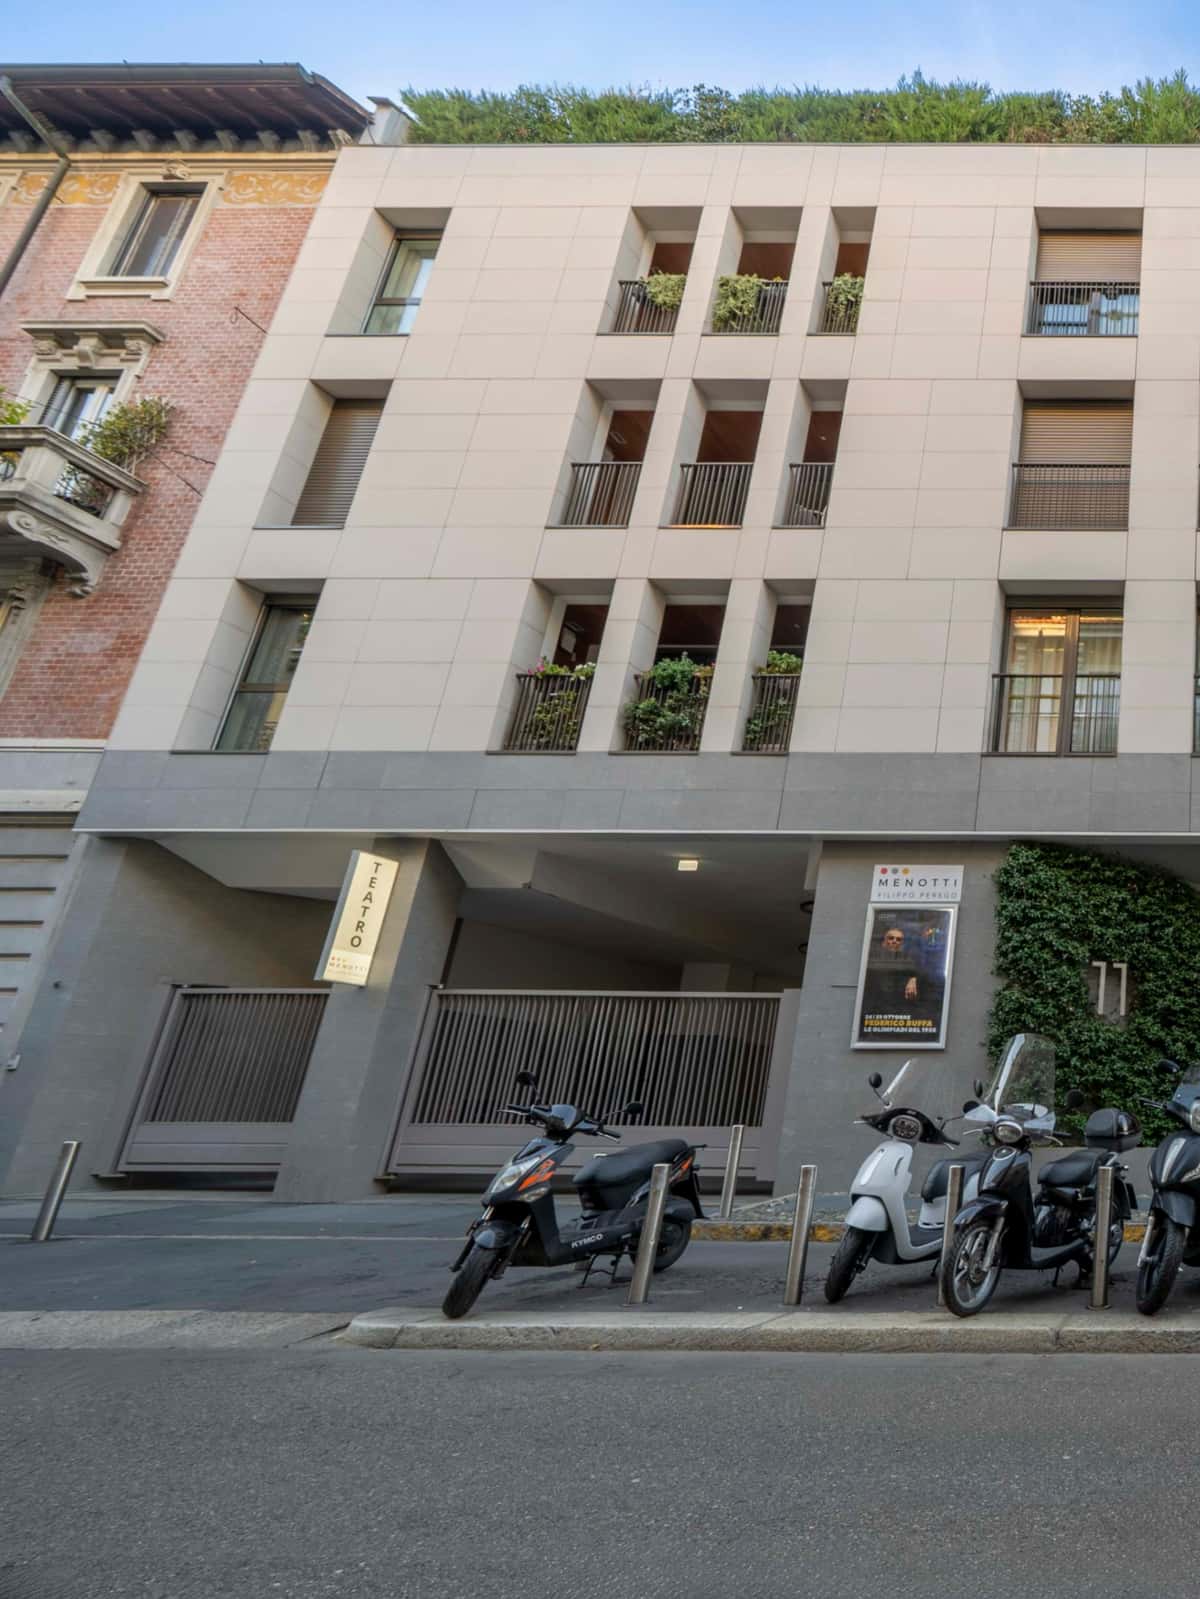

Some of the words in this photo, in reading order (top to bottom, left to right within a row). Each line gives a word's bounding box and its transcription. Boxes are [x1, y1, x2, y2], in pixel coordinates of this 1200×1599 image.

[878, 878, 958, 888] MENOTTI
[350, 861, 383, 949] TEATRO
[1091, 960, 1128, 1017] 11
[571, 1233, 604, 1249] KYMCO
